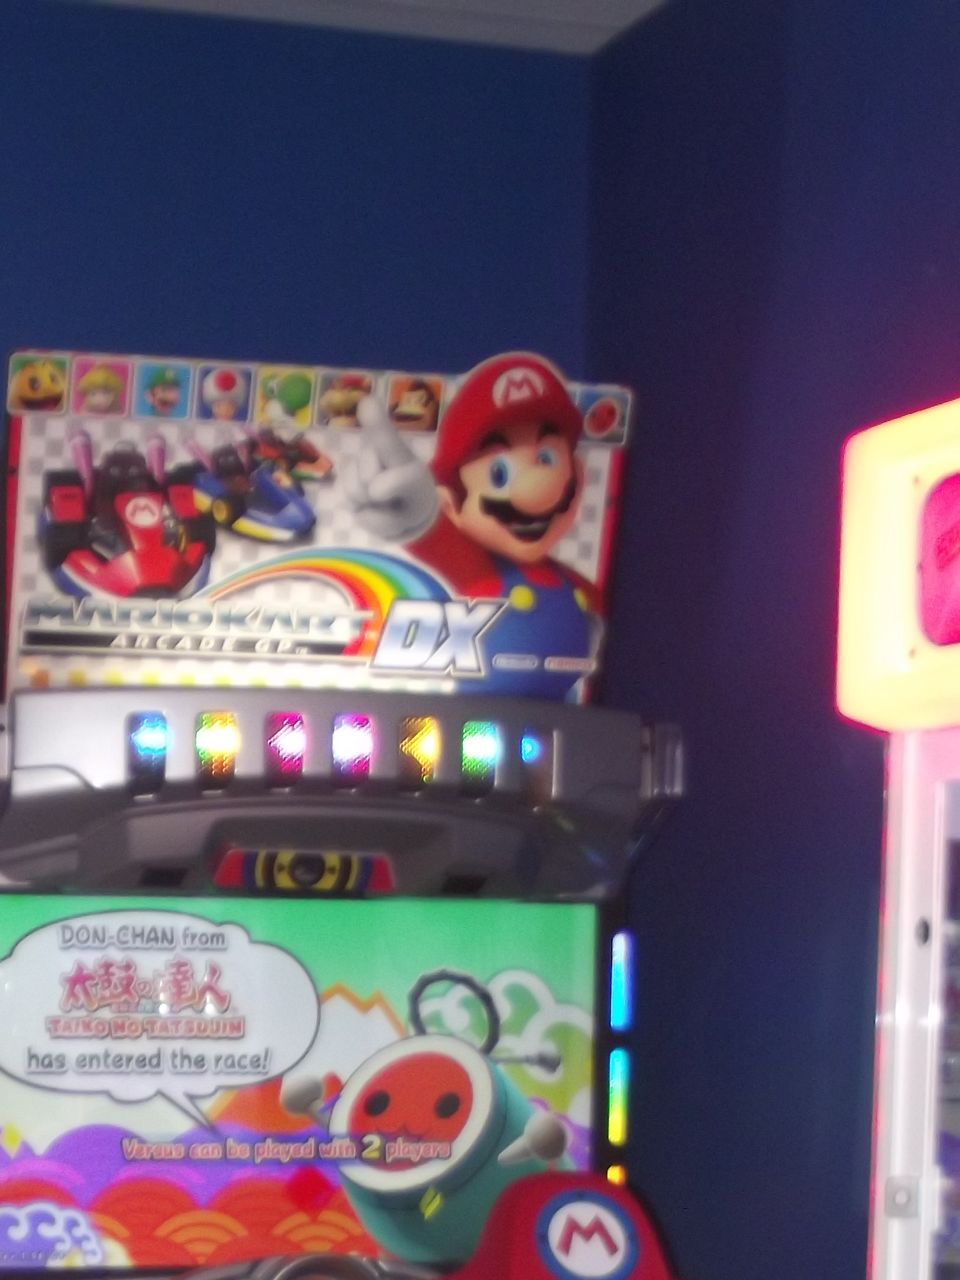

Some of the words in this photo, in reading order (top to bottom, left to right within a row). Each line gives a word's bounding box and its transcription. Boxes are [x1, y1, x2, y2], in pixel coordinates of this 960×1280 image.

[109, 633, 236, 653] ARCADE
[371, 599, 509, 675] DX
[60, 925, 174, 945] DON-CHAN
[182, 926, 225, 946] from
[48, 1017, 108, 1037] TAIKO
[112, 1017, 141, 1036] NO
[147, 1017, 244, 1036] TATSUJIN
[27, 1048, 66, 1069] has
[75, 1048, 161, 1069] entered
[171, 1048, 206, 1069] the
[214, 1048, 270, 1069] race!
[121, 1138, 185, 1160] Versus
[190, 1143, 222, 1159] can
[226, 1138, 250, 1159] be
[254, 1137, 315, 1164] played
[319, 1137, 356, 1159] with
[362, 1134, 381, 1159] 2
[386, 1136, 451, 1163] players
